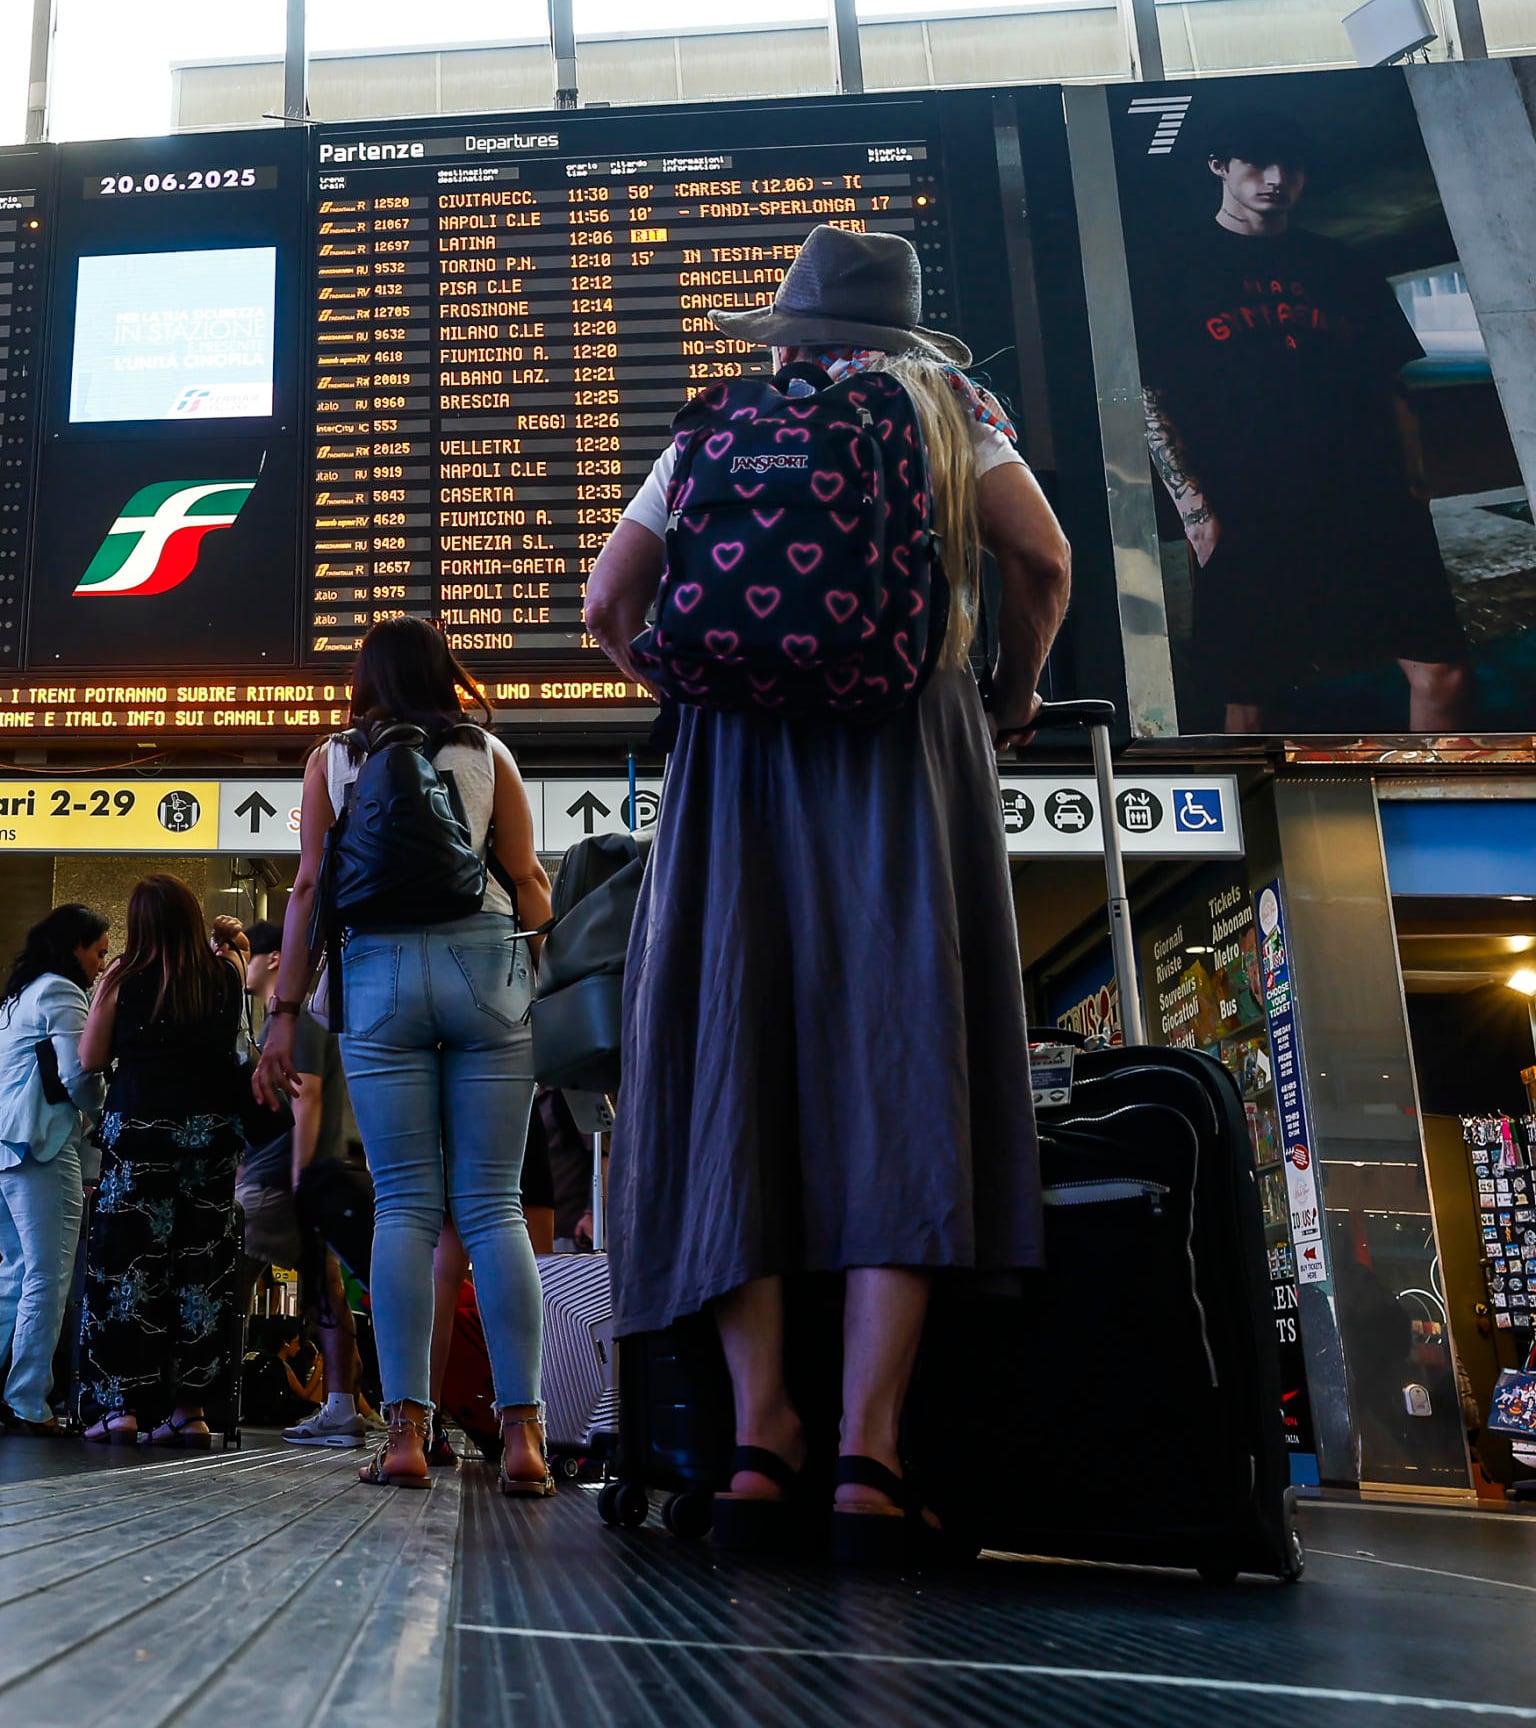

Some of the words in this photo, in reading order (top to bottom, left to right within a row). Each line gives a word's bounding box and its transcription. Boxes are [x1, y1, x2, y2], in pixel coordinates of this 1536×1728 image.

[319, 141, 424, 163] Partenze
[466, 133, 559, 153] Departures
[662, 156, 724, 166] informazioni
[662, 162, 721, 173] information
[100, 168, 257, 195] 20.06.2025
[437, 168, 499, 177] destinazione
[437, 174, 495, 184] destination
[438, 190, 537, 209] CIVITAVECC.
[568, 187, 609, 203] 11:30
[439, 214, 497, 230] NAPOLI
[506, 211, 541, 227] C.LE
[569, 208, 610, 225] 11:56
[699, 198, 856, 218] FONDI-SPERLONGA
[870, 195, 891, 211] 17
[439, 235, 496, 252] LATINA
[569, 230, 613, 246] 12:06
[374, 262, 406, 274] 9532
[439, 257, 496, 274] TORINO
[506, 256, 537, 271] P.N.
[570, 252, 611, 269] 12:10
[439, 280, 477, 296] PISA
[487, 278, 522, 294] C.LE
[571, 275, 612, 291] 12:12
[679, 267, 786, 287] CANCELLATO
[439, 301, 529, 318] FROSINONE
[572, 297, 613, 314] 12:14
[374, 328, 406, 341] 9632
[440, 324, 499, 341] MILANO
[508, 322, 545, 339] C.LE
[573, 320, 617, 336] 12:20
[440, 370, 503, 387] ALBANO
[512, 368, 550, 384] LAZ.
[574, 366, 616, 382] 12:21
[373, 419, 398, 432] 553
[575, 412, 620, 429] 12:26
[440, 438, 521, 456] VELLETRI
[575, 436, 621, 452] 12:28
[730, 454, 808, 474] JANSPORT
[440, 486, 514, 503] CASERTA
[440, 534, 512, 552] VENEZIA
[522, 534, 554, 550] S.L.
[441, 558, 565, 575] FORMIA-GAETA
[10, 688, 21, 704] I
[27, 687, 78, 703] TRENI
[83, 686, 168, 703] POTRANNO
[176, 686, 238, 702] SUBIRE
[245, 685, 315, 702] RITARDI
[322, 685, 336, 701] O
[495, 683, 531, 700] UNO
[539, 682, 627, 699] SCIOPERO
[43, 711, 57, 727] E
[63, 711, 118, 727] ITALO.
[125, 710, 167, 727] INFO
[174, 710, 206, 726] SUI
[212, 710, 276, 726] CANALI
[283, 709, 321, 726] WEB
[330, 710, 342, 726] E
[49, 790, 137, 818] 2-29
[1208, 884, 1242, 920] Tickets
[1212, 905, 1254, 946] Abbonam
[1153, 924, 1184, 961] Giornali
[1214, 942, 1240, 972] Metro
[1155, 954, 1183, 985] Riviste
[1159, 974, 1197, 1012] Souvenirs
[1266, 981, 1290, 1000] CHOOSE
[1270, 993, 1287, 1007] YOUR
[1161, 994, 1199, 1034] Giocattoli
[1219, 997, 1238, 1020] Bus
[1269, 1001, 1292, 1019] TICKET
